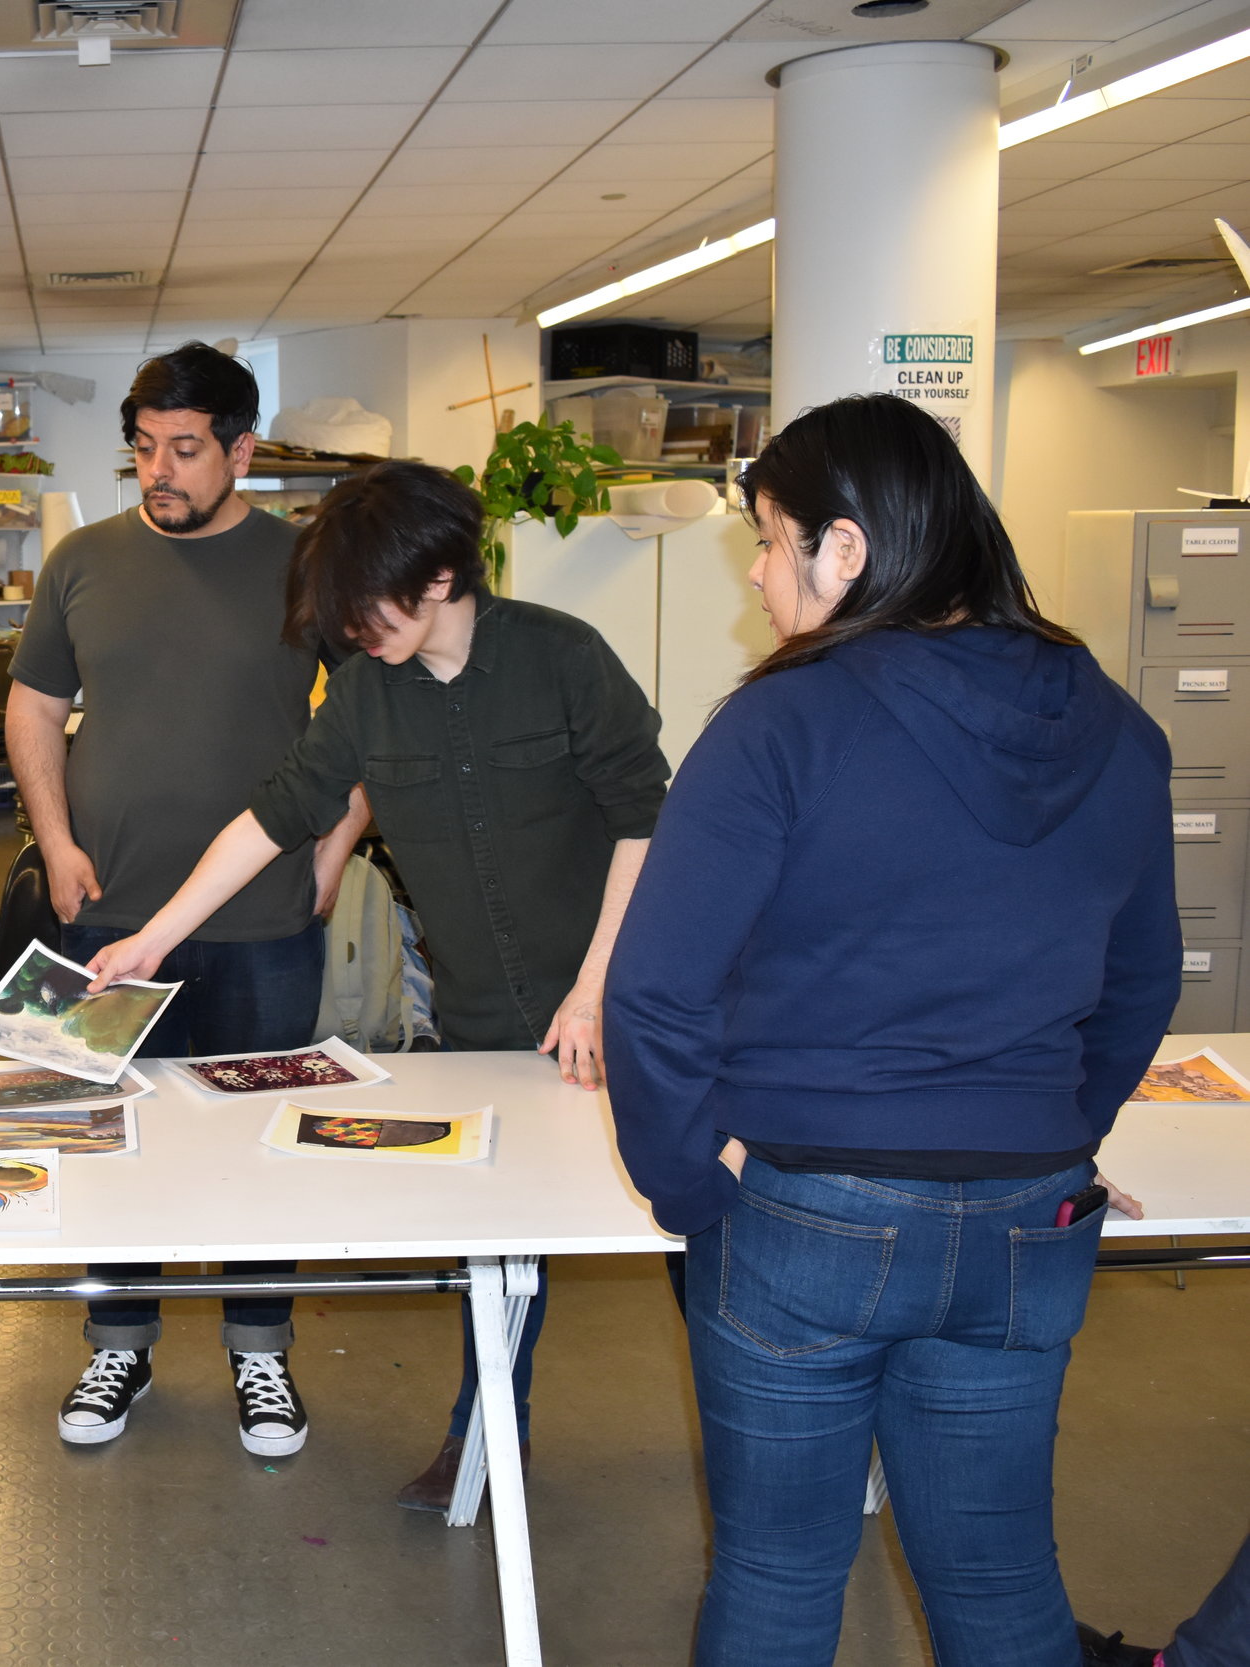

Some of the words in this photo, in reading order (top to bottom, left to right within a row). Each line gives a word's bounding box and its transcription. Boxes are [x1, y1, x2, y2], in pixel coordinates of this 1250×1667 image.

[886, 337, 902, 361] BE
[905, 336, 972, 361] CONSIDERATE
[1136, 336, 1173, 376] EXIT
[897, 371, 943, 385] CLEAN
[947, 371, 964, 385] UP
[888, 388, 921, 399] AFTER
[924, 388, 970, 399] YOURSELF
